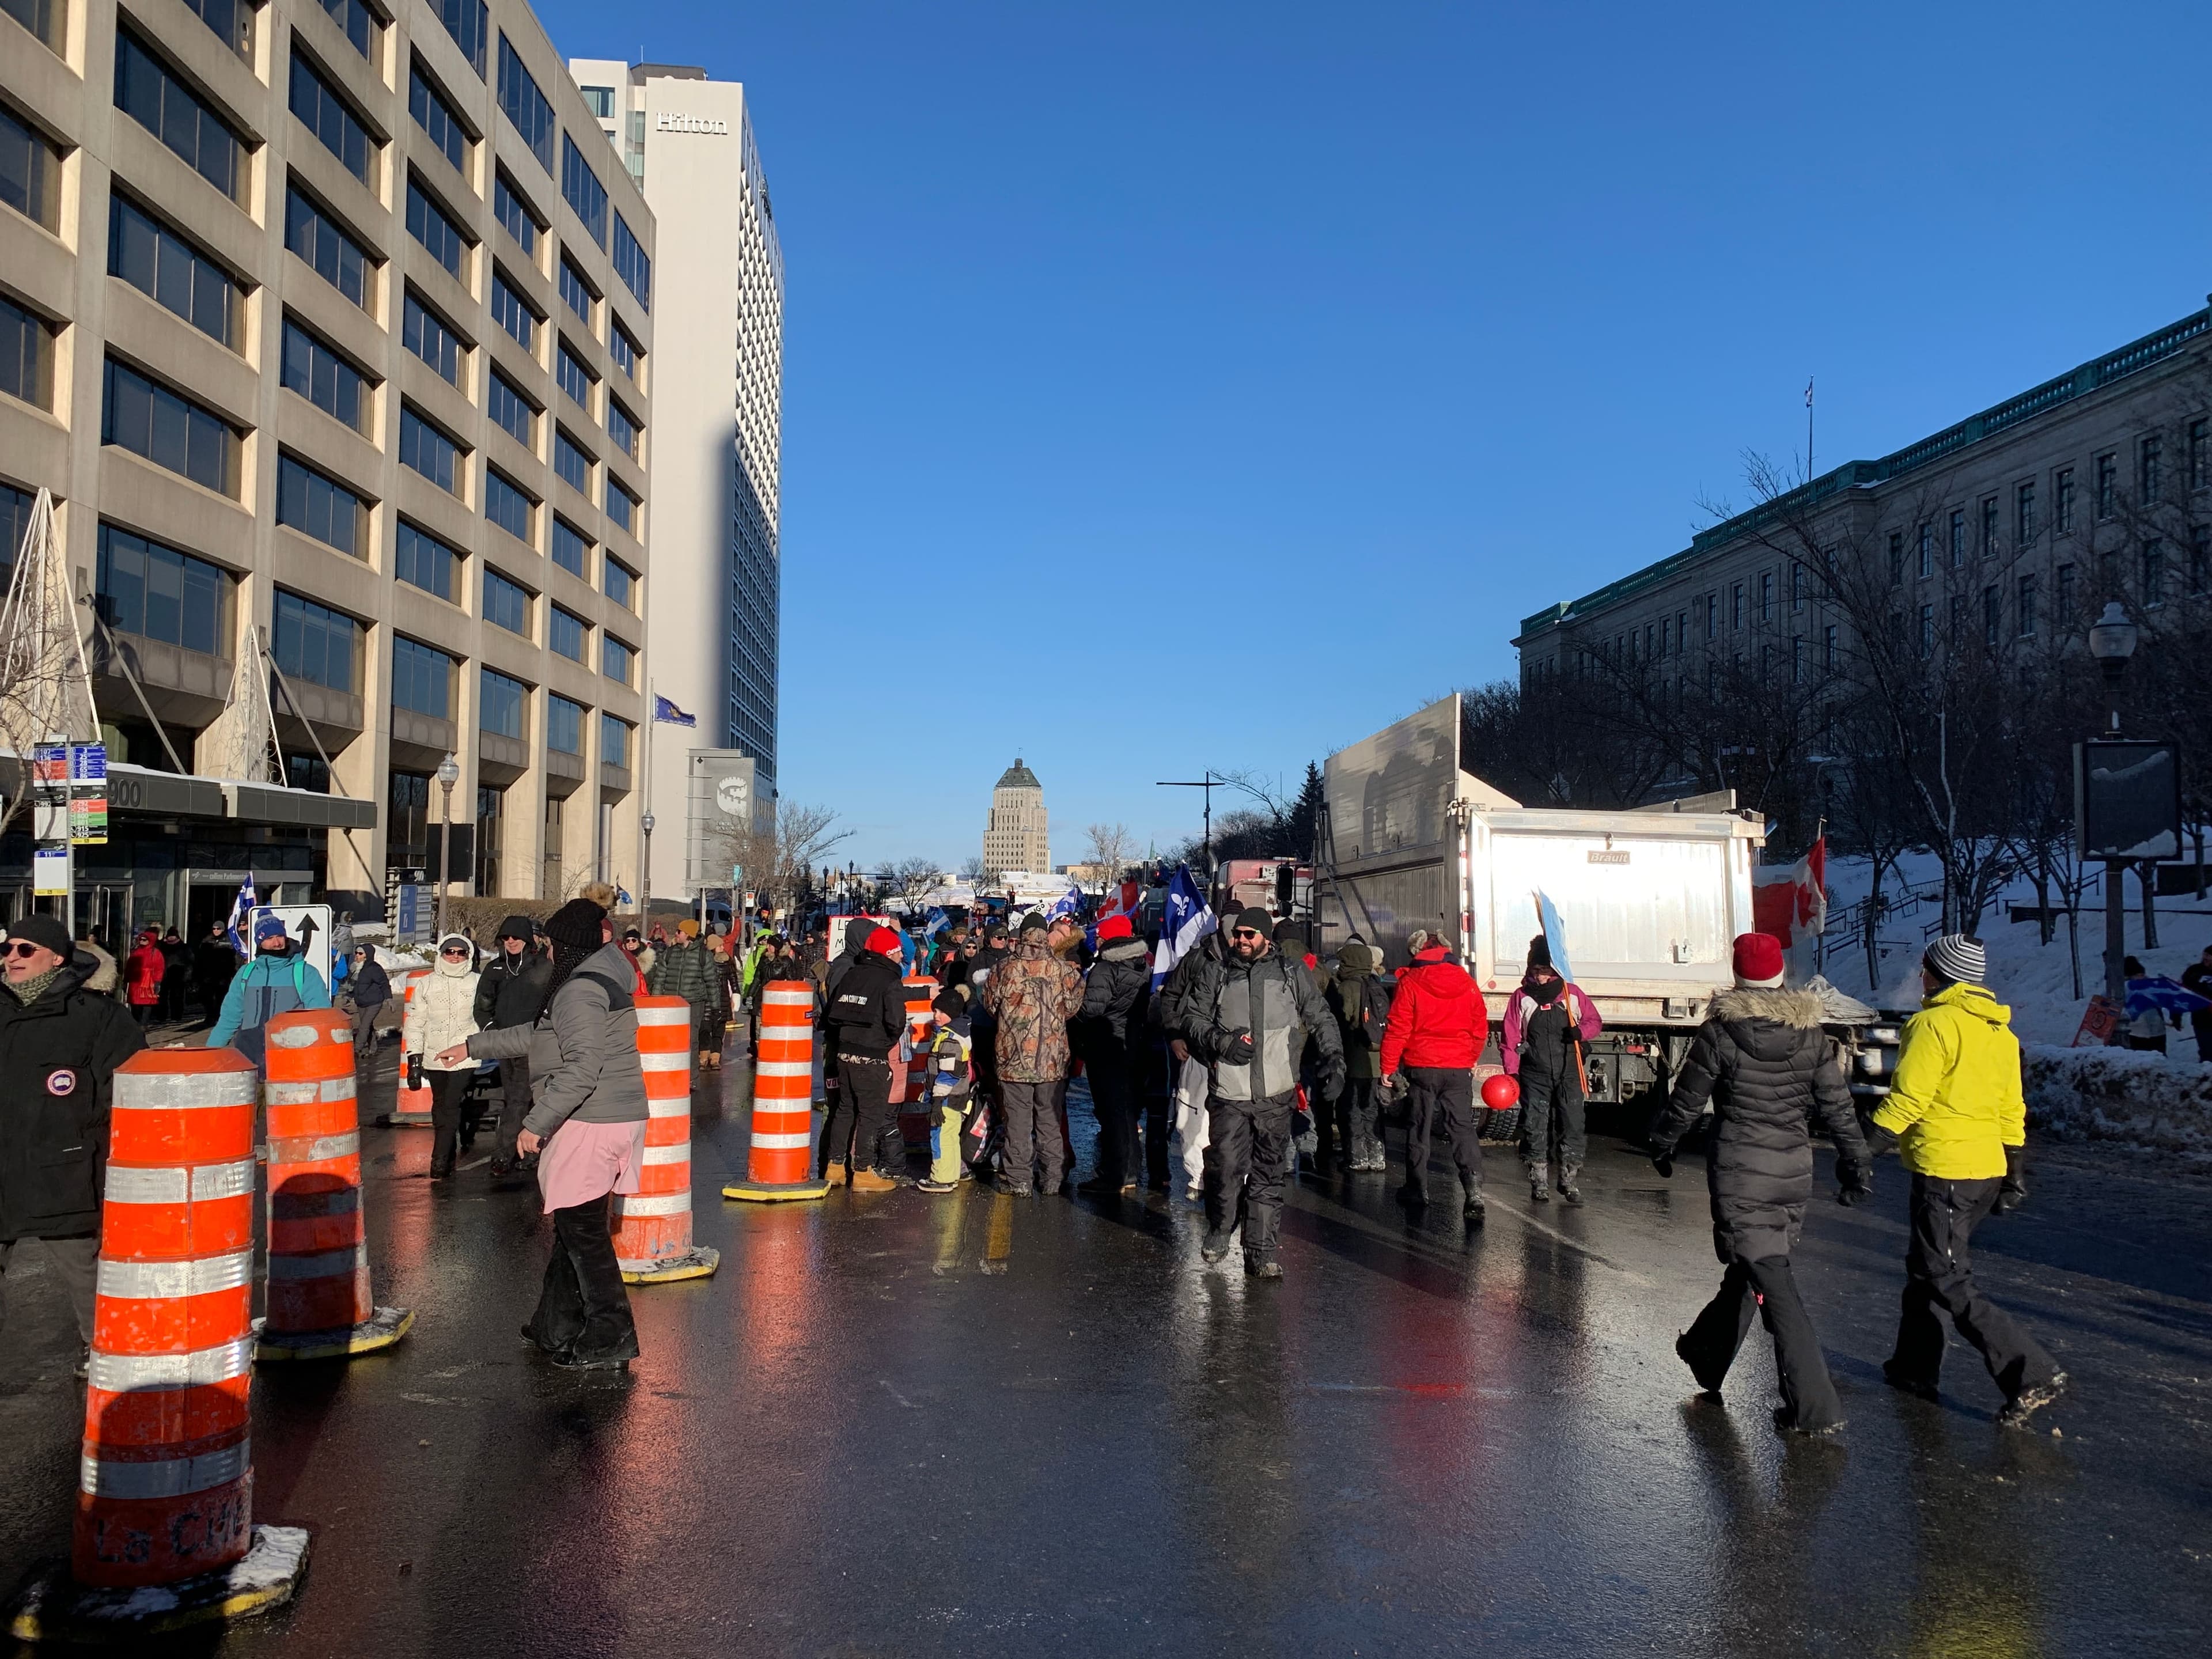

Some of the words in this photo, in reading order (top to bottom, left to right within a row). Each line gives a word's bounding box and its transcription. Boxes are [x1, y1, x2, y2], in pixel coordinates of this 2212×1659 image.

[656, 112, 728, 135] Hilton
[108, 779, 141, 807] 900
[1590, 853, 1628, 862] Brault
[96, 1519, 151, 1563] La
